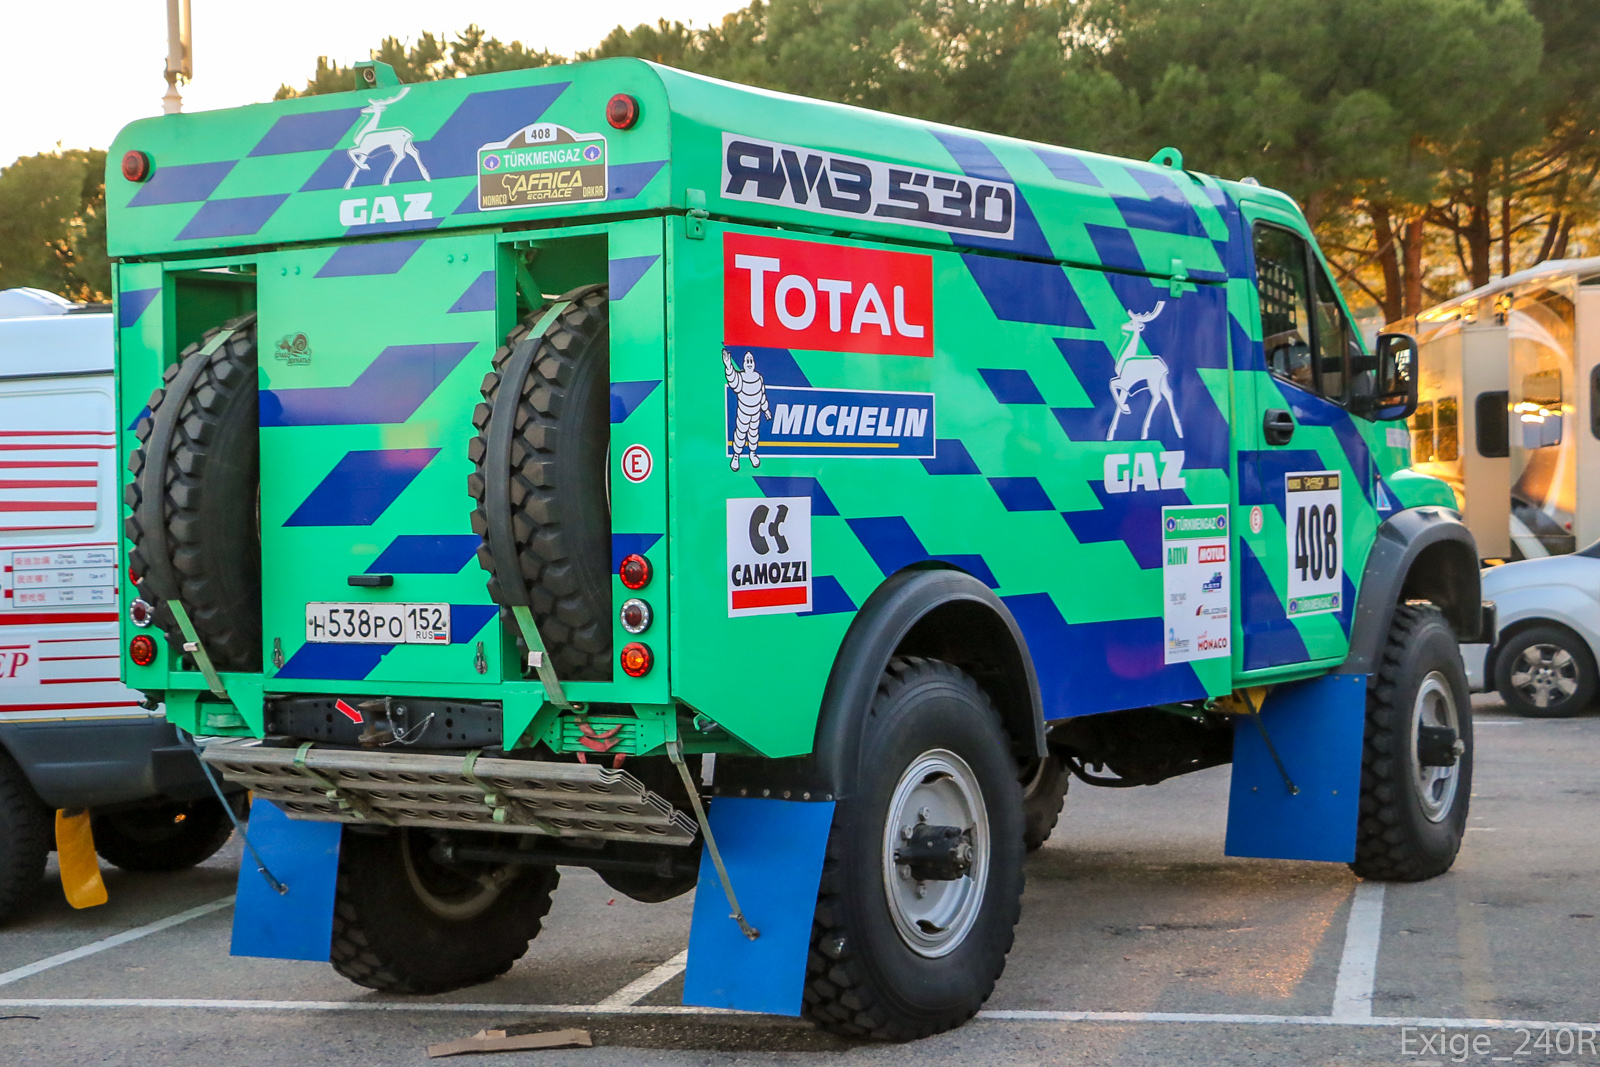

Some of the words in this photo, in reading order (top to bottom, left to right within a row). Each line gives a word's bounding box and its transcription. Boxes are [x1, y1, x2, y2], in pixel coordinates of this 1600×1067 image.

[531, 128, 551, 139] 408
[503, 148, 580, 168] TÜRKMENGAZ
[512, 170, 583, 196] AFRICA
[582, 185, 604, 198] DAKAR
[339, 192, 433, 226] GAZ
[482, 194, 508, 206] MONACO
[873, 168, 1013, 234] 530
[734, 253, 925, 338] TOTAL
[771, 403, 928, 437] MICHELIN
[632, 454, 643, 473] E
[1103, 450, 1186, 494] GAZ
[1176, 515, 1217, 531] TÜRKMENGAZ
[1295, 504, 1337, 581] 408
[1199, 546, 1225, 562] MOTUL
[731, 561, 807, 587] CAMOZZI
[408, 608, 442, 631] 152
[416, 631, 433, 640] RUS
[1197, 637, 1228, 651] MONACO
